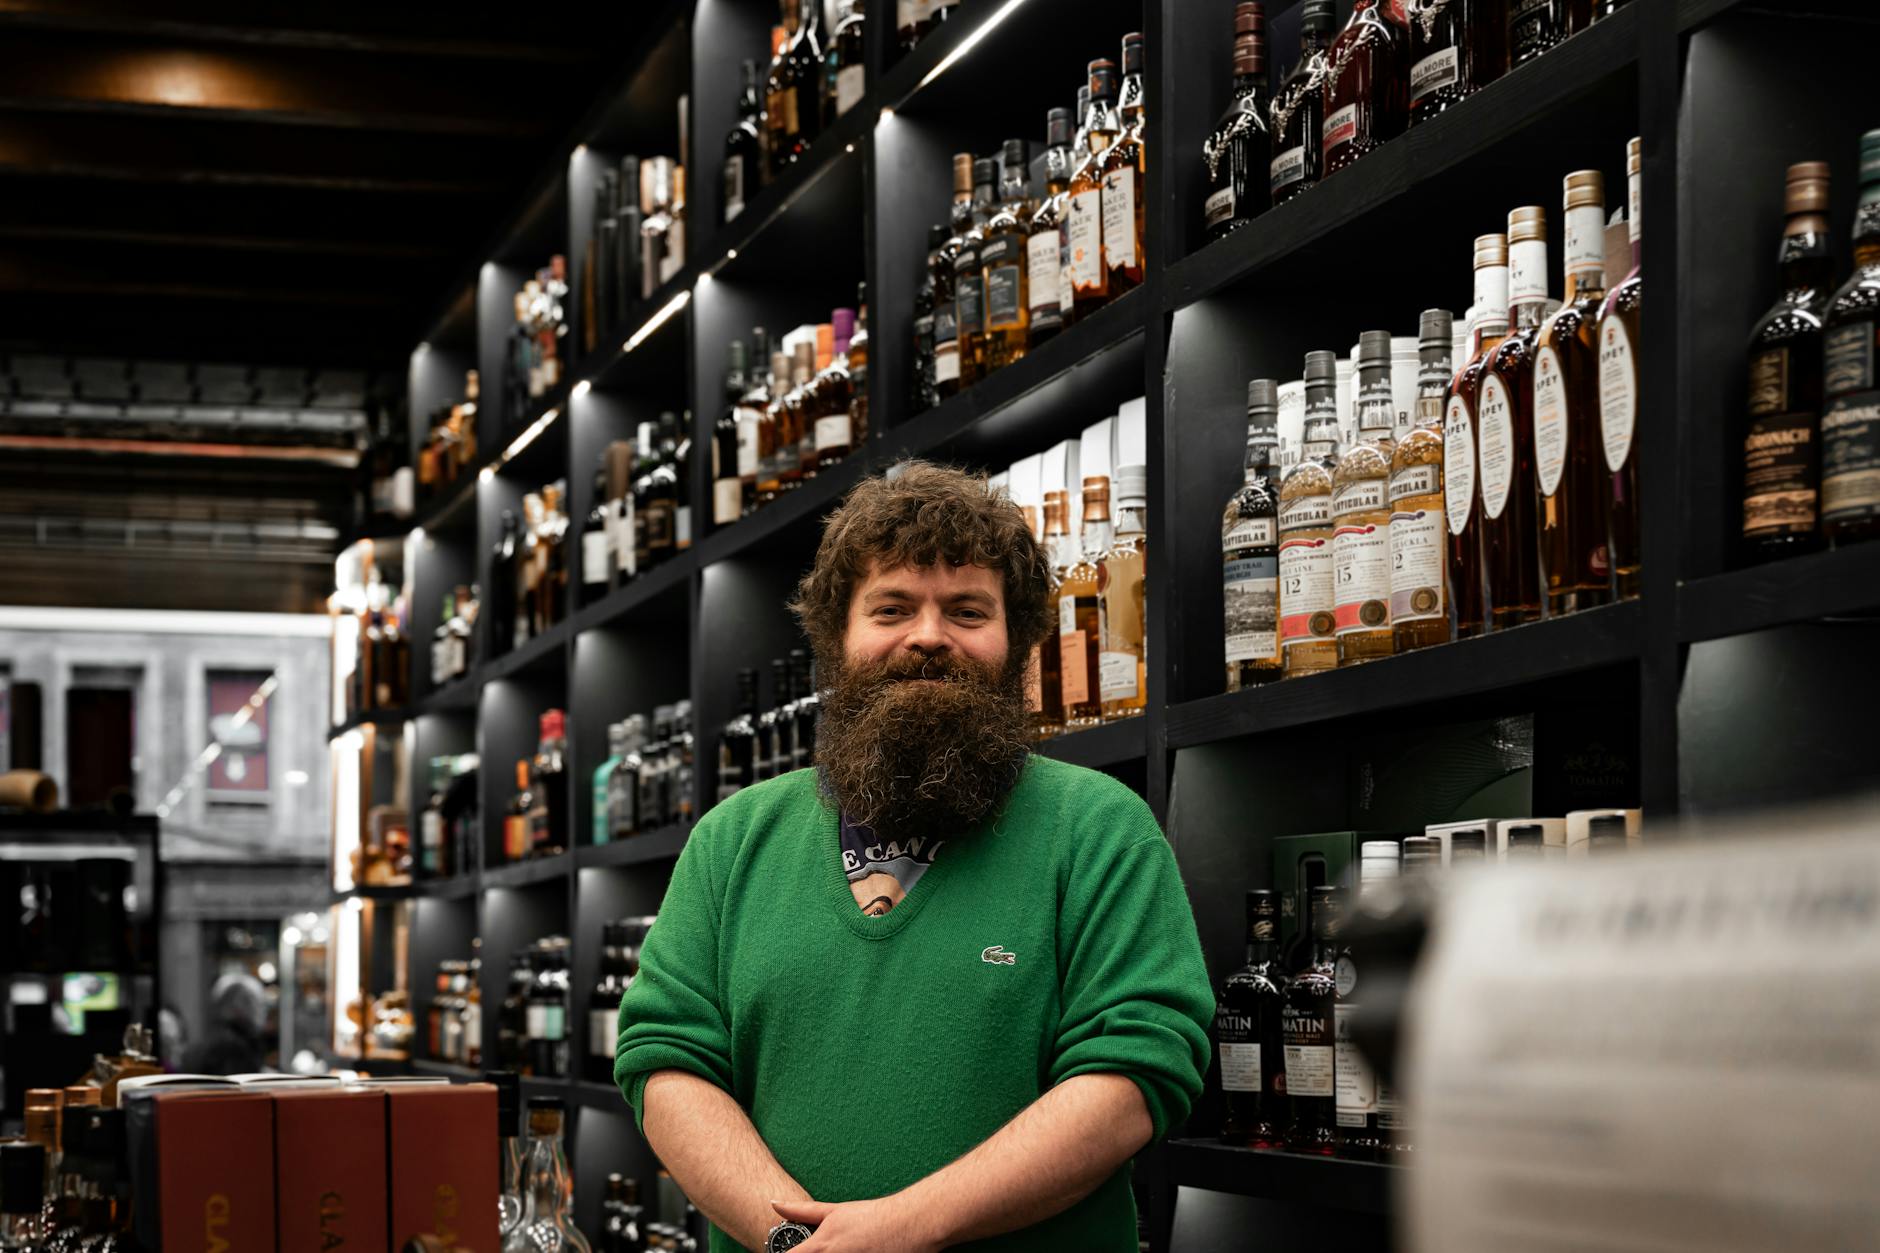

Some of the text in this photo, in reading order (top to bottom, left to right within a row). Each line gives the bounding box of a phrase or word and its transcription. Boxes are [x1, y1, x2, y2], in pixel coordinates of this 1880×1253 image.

[1412, 55, 1454, 83] DALMORE
[1481, 402, 1503, 419] SPEY
[1446, 422, 1467, 437] SPEY
[1337, 566, 1352, 585] 15
[1285, 578, 1301, 595] 12
[842, 849, 861, 872] E
[864, 836, 928, 861] CAN
